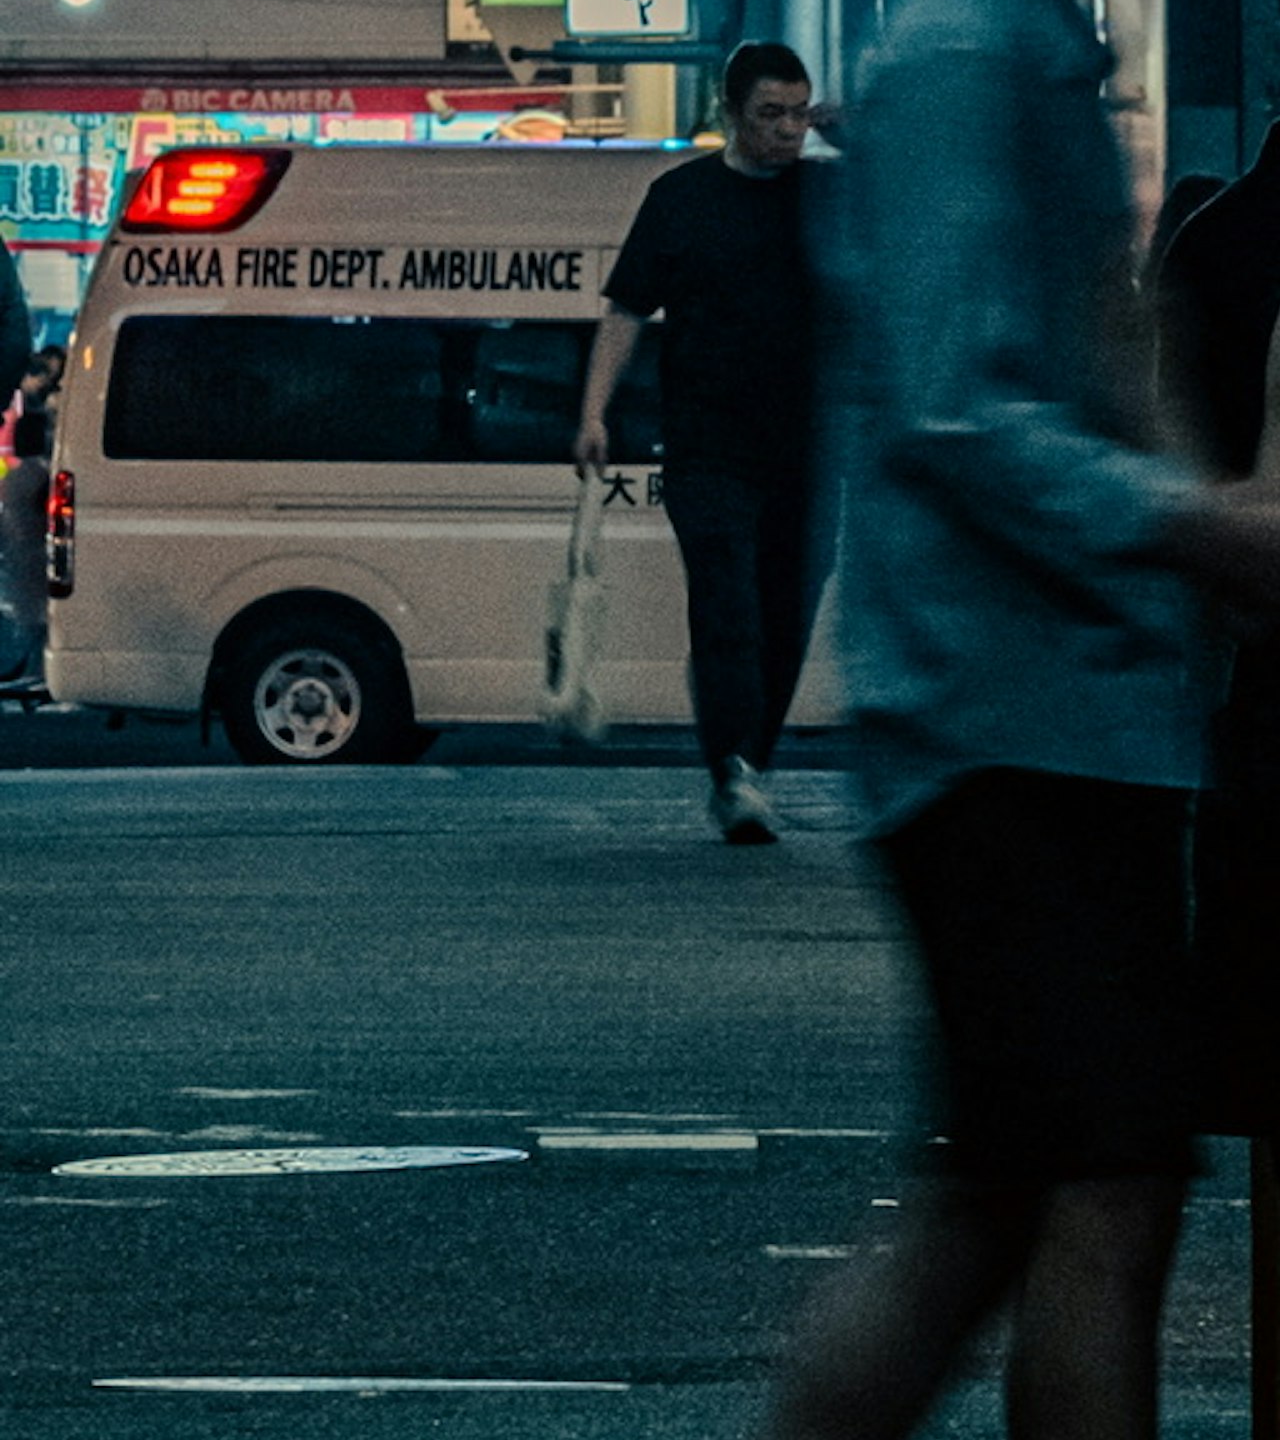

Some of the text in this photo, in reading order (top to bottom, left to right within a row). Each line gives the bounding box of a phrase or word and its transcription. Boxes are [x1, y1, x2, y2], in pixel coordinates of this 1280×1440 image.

[172, 88, 355, 111] BIC CAMERA
[123, 247, 583, 292] OSAKA FIRE DEPT. AMBULANCE
